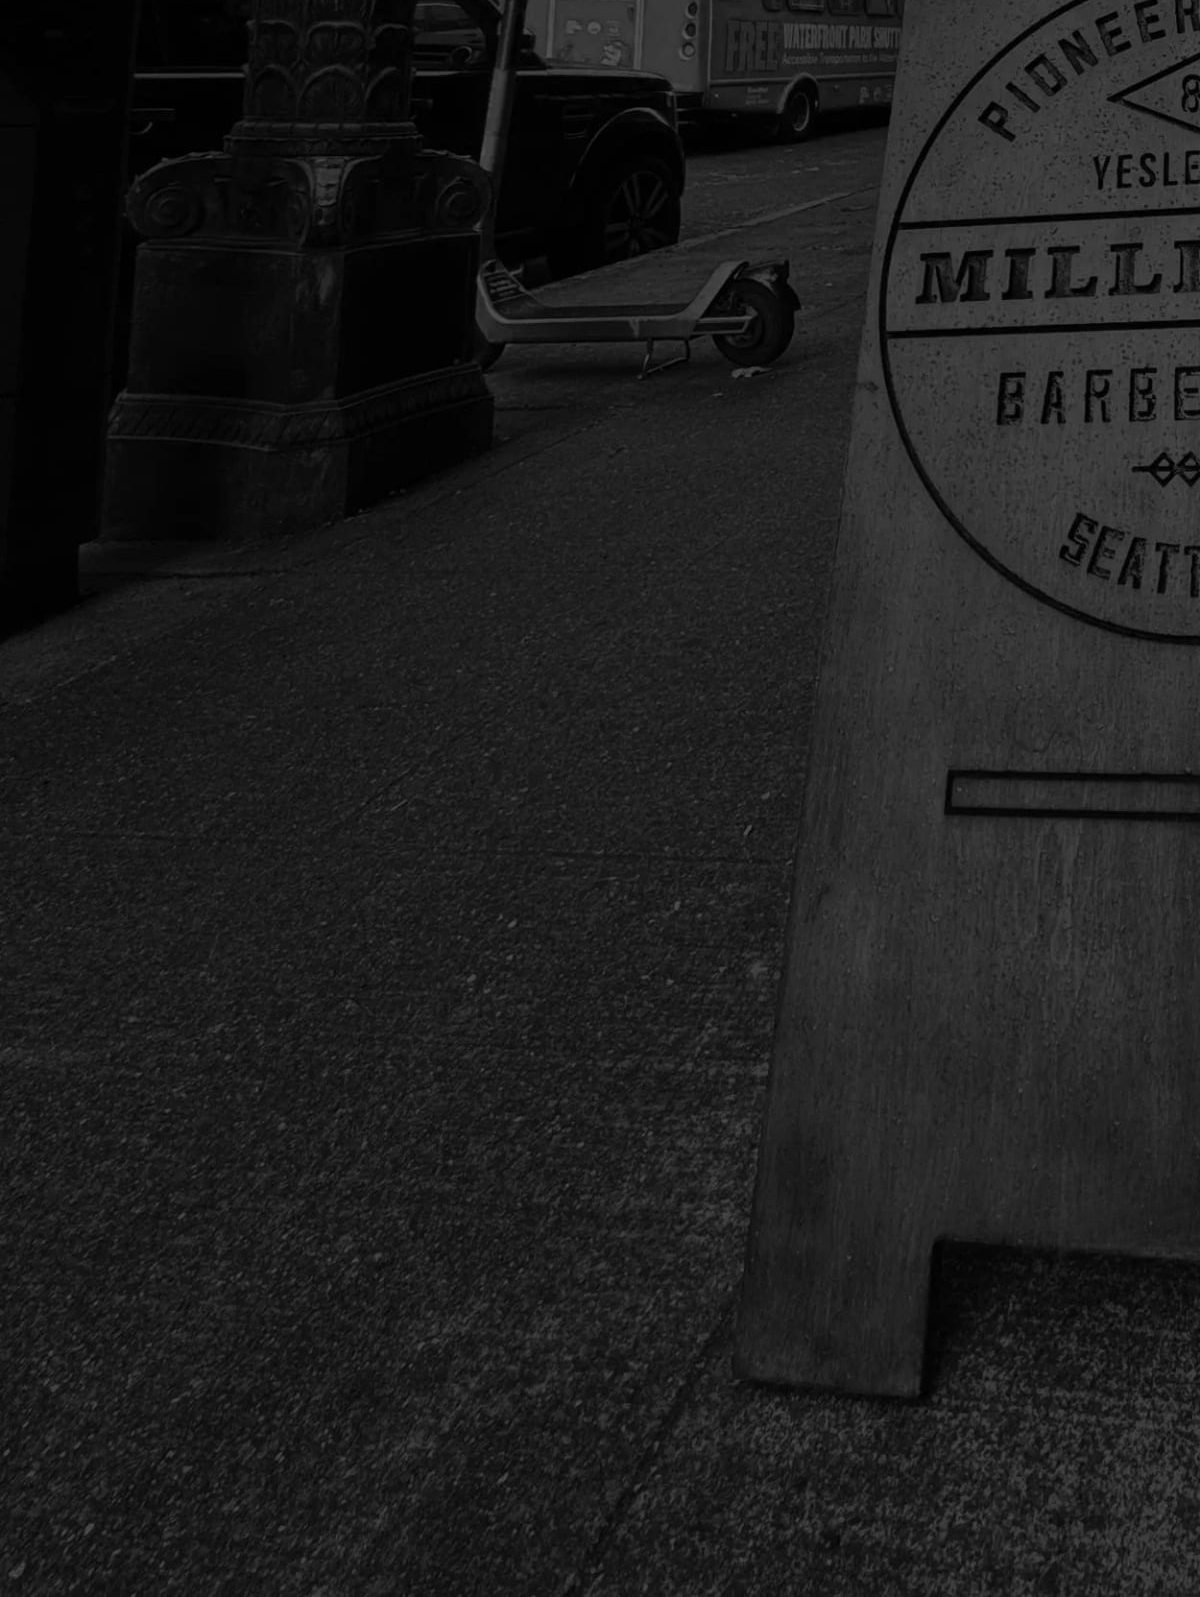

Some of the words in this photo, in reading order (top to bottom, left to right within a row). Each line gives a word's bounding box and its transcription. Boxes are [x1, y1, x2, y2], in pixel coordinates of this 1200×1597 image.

[724, 19, 779, 73] FREE
[783, 23, 849, 50] WATERFRONT
[849, 25, 873, 49] PARK
